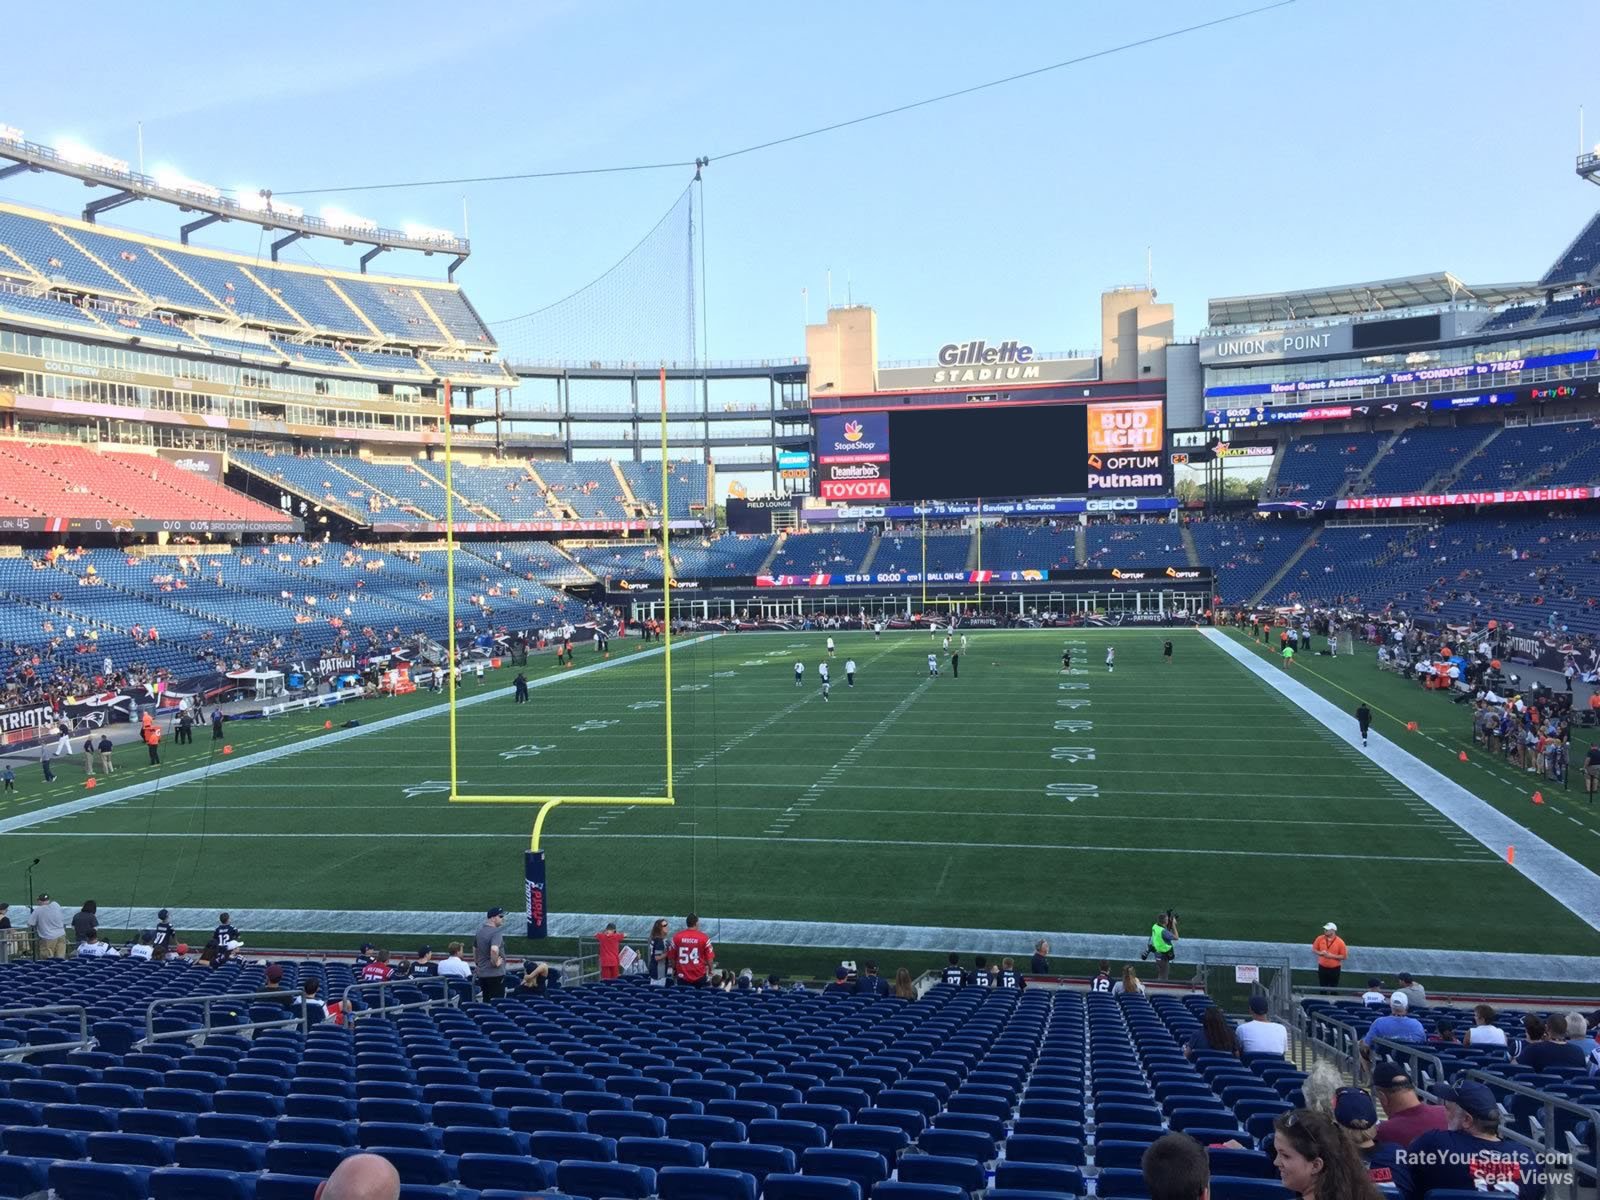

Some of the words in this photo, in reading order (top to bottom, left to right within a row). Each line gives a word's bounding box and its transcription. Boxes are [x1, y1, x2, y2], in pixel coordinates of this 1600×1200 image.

[1218, 340, 1265, 356] UNION
[1283, 334, 1331, 351] POINT
[939, 341, 1033, 366] Gillette
[44, 361, 71, 372] COLD
[934, 366, 1039, 383] STADIUM
[1271, 383, 1295, 393] Need
[1298, 381, 1326, 391] Guest
[1328, 375, 1386, 388] Assistance?
[1391, 373, 1414, 383] Text
[1490, 360, 1526, 372] 78247
[1101, 412, 1148, 429] BUD
[1278, 411, 1312, 420] Putnam
[1093, 428, 1155, 447] LIGHT
[834, 442, 875, 451] Stop&Shop
[1107, 456, 1158, 469] OPTUM
[1087, 473, 1162, 488] Putnam
[823, 482, 889, 497] TOYOTA
[1086, 499, 1138, 510] GEICO
[1347, 498, 1391, 509] NEW
[1401, 493, 1497, 507] ENGLAND
[1503, 488, 1590, 502] PATRIOTS
[838, 507, 885, 518] GEICO
[914, 506, 932, 514] Over
[948, 505, 970, 513] Years
[983, 504, 1014, 513] Savings
[1025, 503, 1056, 511] Service
[17, 518, 30, 529] 45
[475, 521, 553, 532] ENGLAND
[561, 520, 646, 530] PATRIOTS
[877, 573, 900, 581] 60:00
[944, 572, 954, 580] ON
[970, 618, 997, 626] PATRIOTS
[0, 705, 53, 732] TRIOTS
[218, 934, 230, 945] 12
[678, 946, 699, 964] 54
[1003, 977, 1016, 988] 12
[1092, 978, 1110, 992] 12
